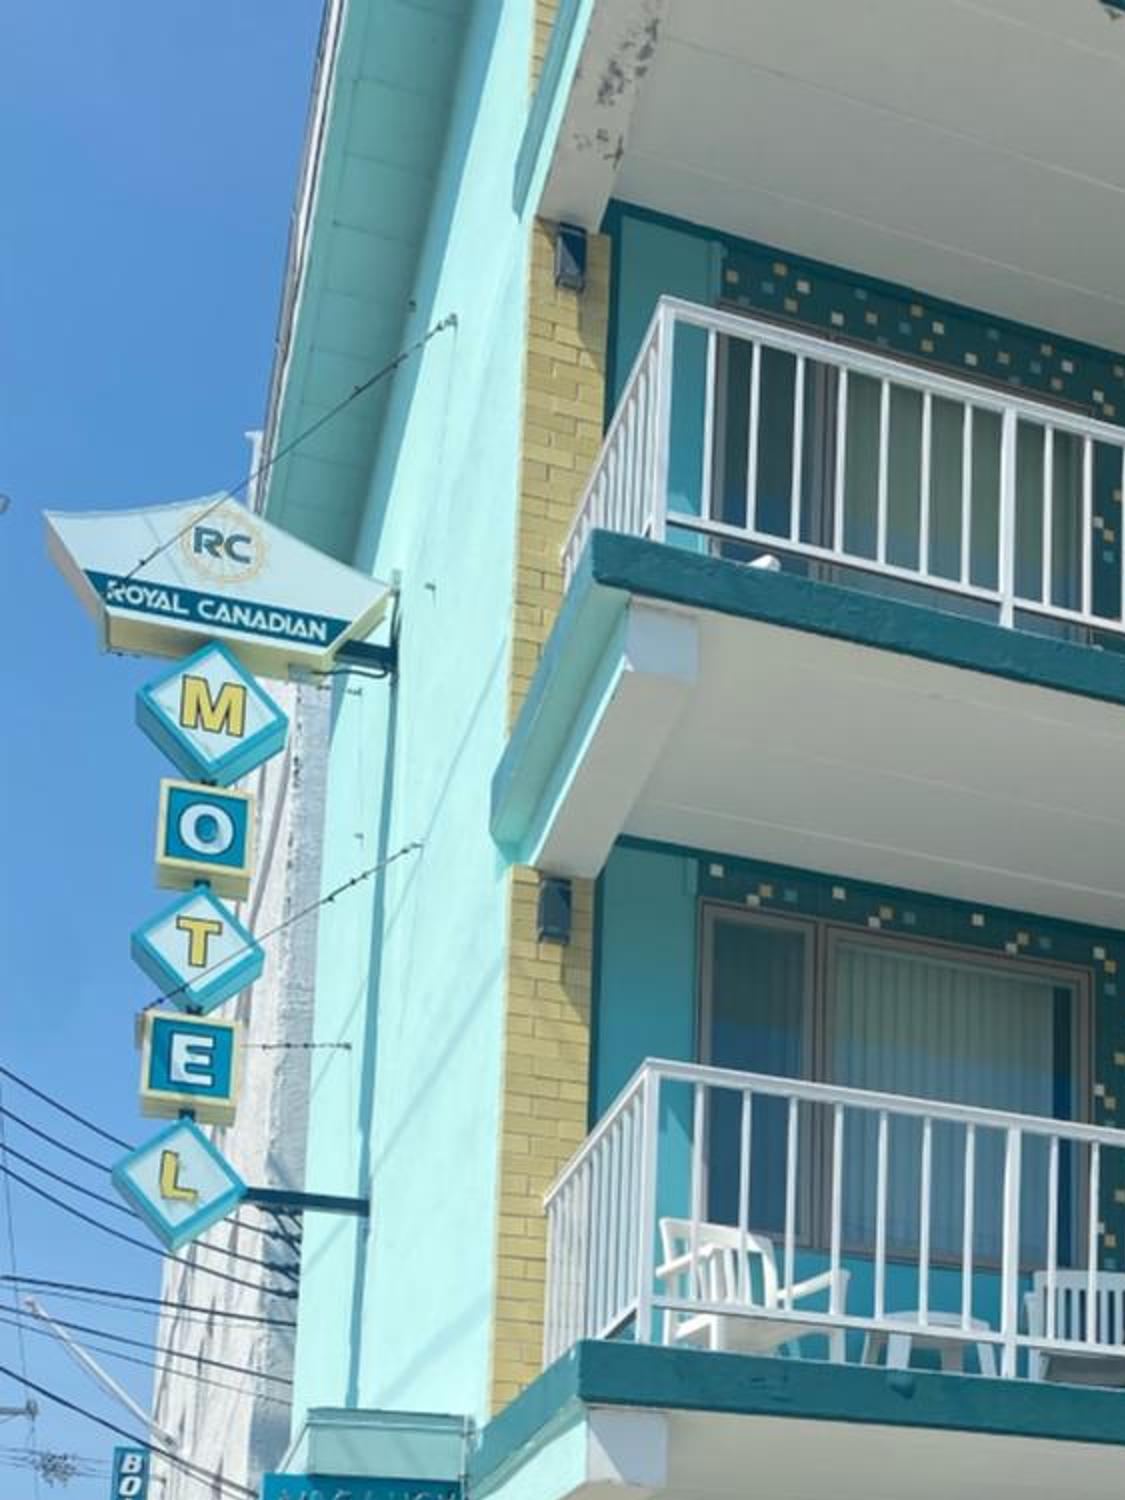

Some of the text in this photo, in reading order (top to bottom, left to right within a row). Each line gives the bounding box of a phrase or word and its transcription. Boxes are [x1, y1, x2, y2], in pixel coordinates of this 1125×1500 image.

[194, 525, 251, 564] RC
[106, 579, 327, 641] ROYAL CANADIAN
[158, 674, 247, 1203] MOTEL
